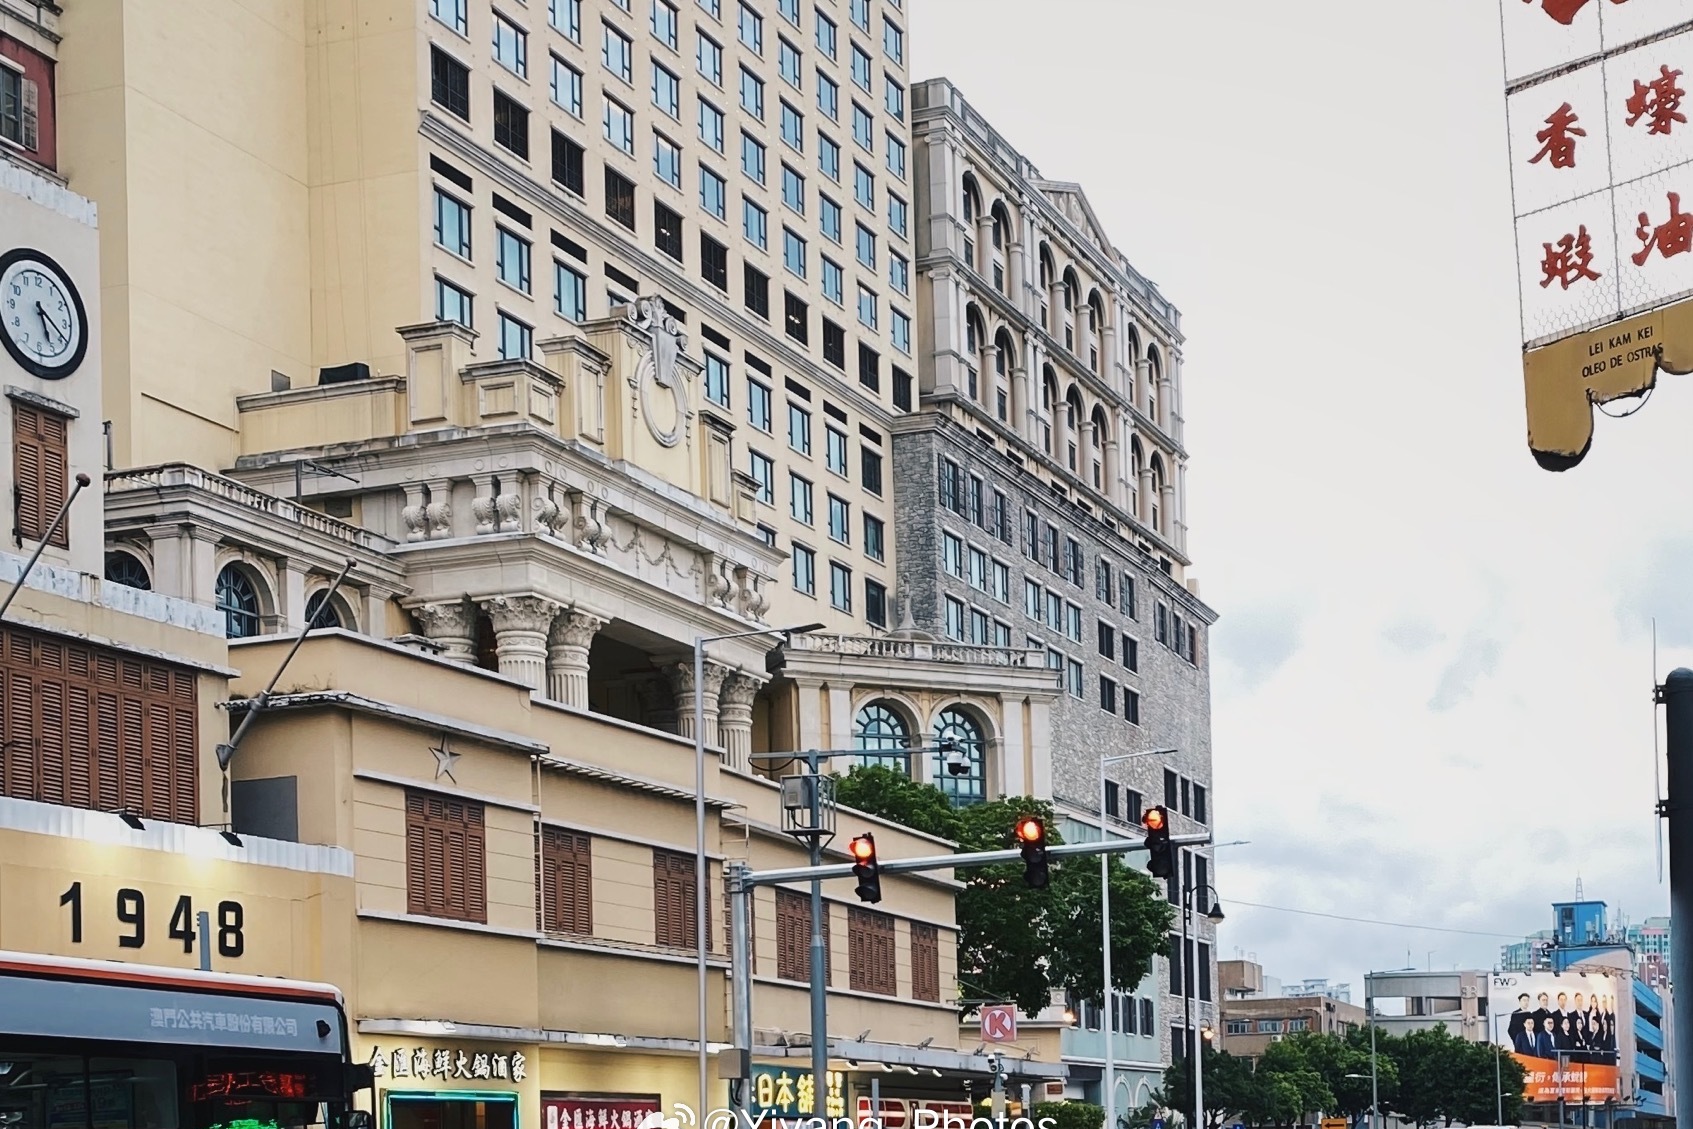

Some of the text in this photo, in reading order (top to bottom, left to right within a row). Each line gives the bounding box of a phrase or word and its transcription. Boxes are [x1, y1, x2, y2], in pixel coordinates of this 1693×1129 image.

[34, 276, 43, 289] 12
[1589, 326, 1653, 356] LEI KAM KEI
[1582, 342, 1664, 378] OLEO DE OSTRAS
[60, 882, 244, 957] 1948
